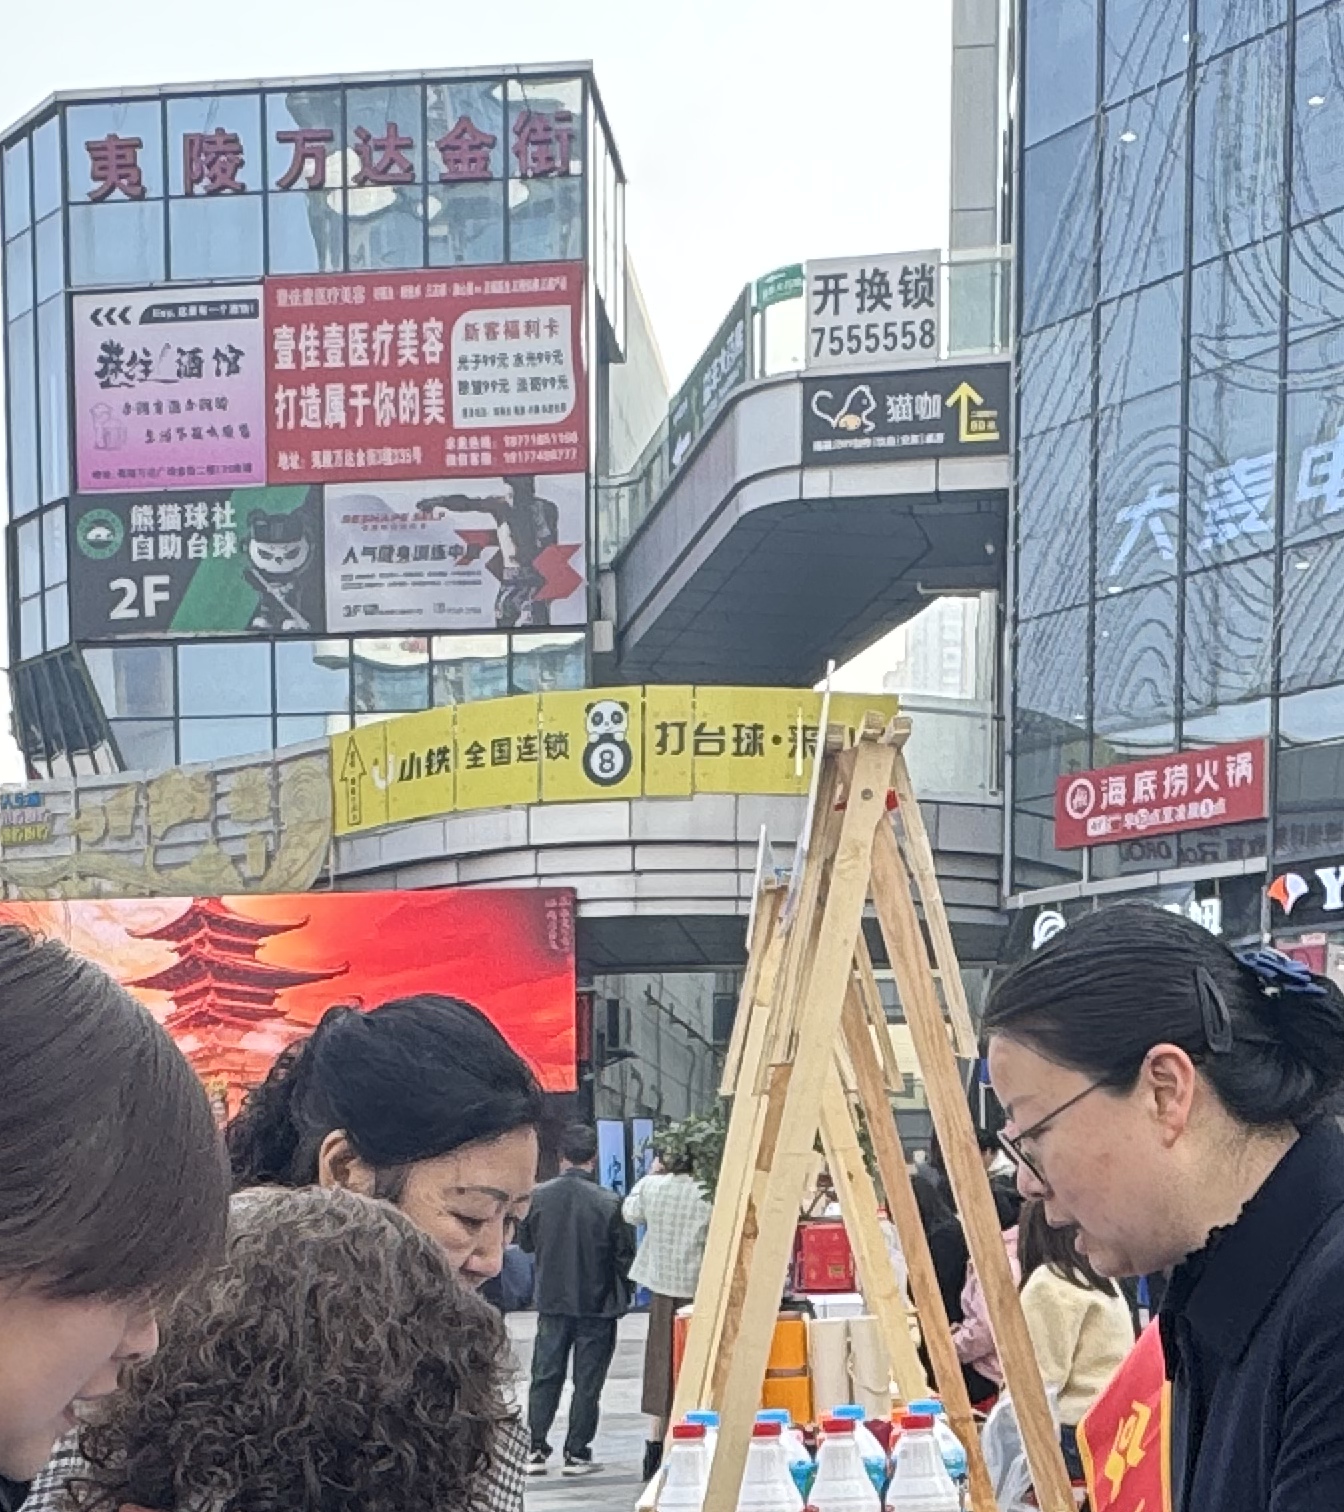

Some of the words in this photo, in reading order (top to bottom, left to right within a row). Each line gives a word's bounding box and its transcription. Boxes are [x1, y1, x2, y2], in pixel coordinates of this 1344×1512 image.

[85, 112, 575, 201] 夷陵万达金街
[812, 262, 936, 316] 开换锁
[273, 317, 444, 370] 壹佳壹医疗美容
[463, 317, 560, 342] 新客福利卡
[811, 319, 936, 358] 7555558
[274, 377, 446, 430] 打造属于你的美
[885, 391, 942, 423] 猫咖
[130, 500, 237, 533] 熊猫球社
[130, 531, 238, 562] 自助台球
[109, 575, 170, 620] 2F
[397, 744, 452, 783] 小铁
[463, 732, 570, 771] 全国连锁
[1100, 751, 1253, 810] 海底捞火锅
